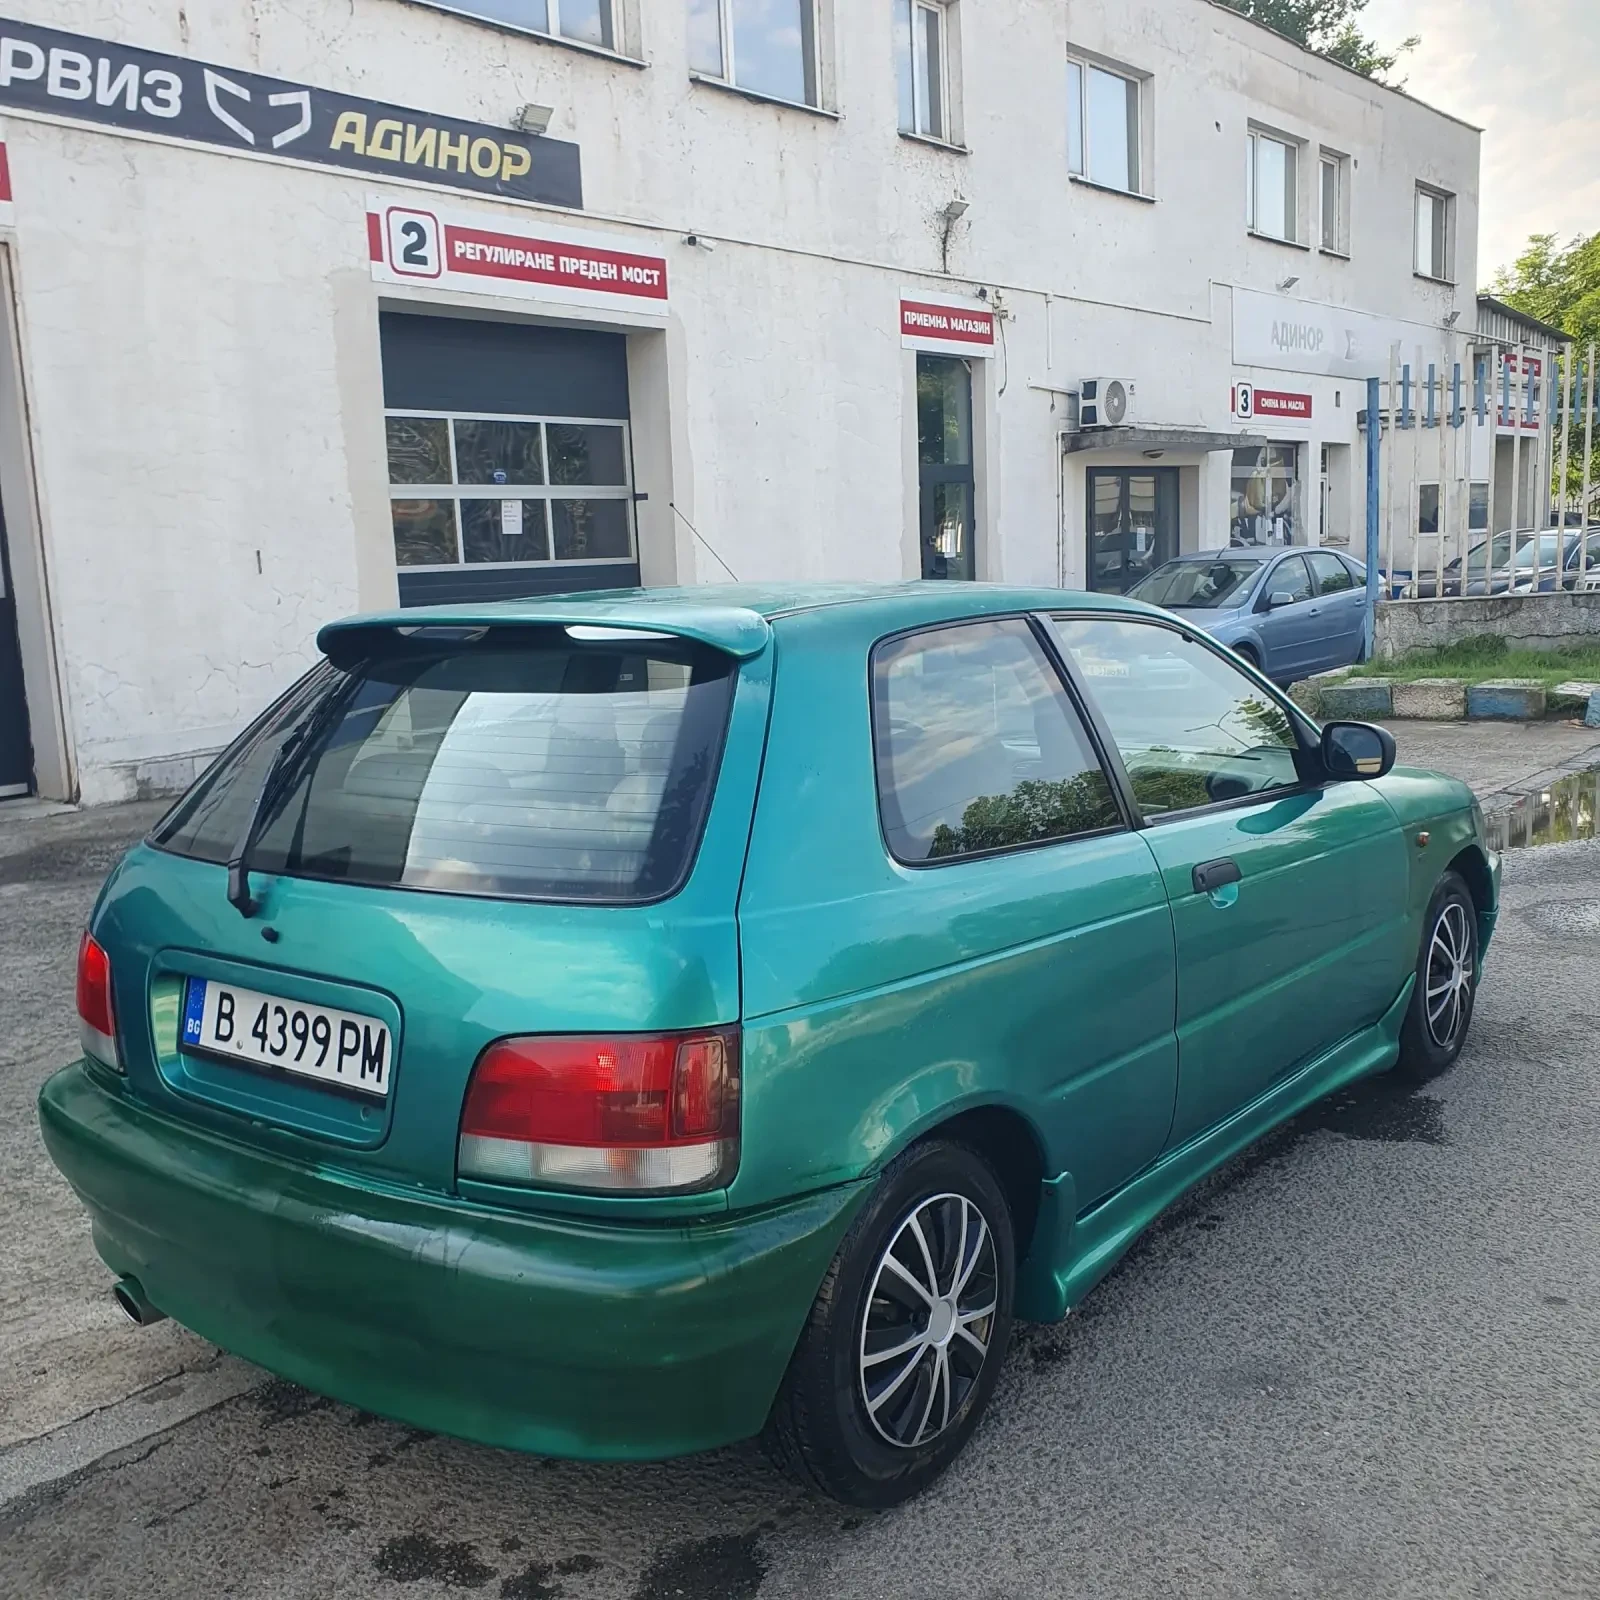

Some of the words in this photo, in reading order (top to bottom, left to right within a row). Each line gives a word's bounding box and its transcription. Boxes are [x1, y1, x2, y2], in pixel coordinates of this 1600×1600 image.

[0, 37, 183, 118] РВИЗ
[330, 110, 532, 182] АДИНОР
[402, 221, 428, 266] 2
[454, 240, 556, 272] РЕГУЛИРАНЕ
[559, 256, 618, 280] ПРЕДЕН
[622, 265, 660, 286] МОСТ
[904, 311, 948, 330] ПРИЕМНА
[951, 318, 991, 335] МАГАЗИН
[1271, 320, 1324, 352] АДИНОР
[1240, 389, 1249, 413] 3
[187, 1018, 200, 1035] BG
